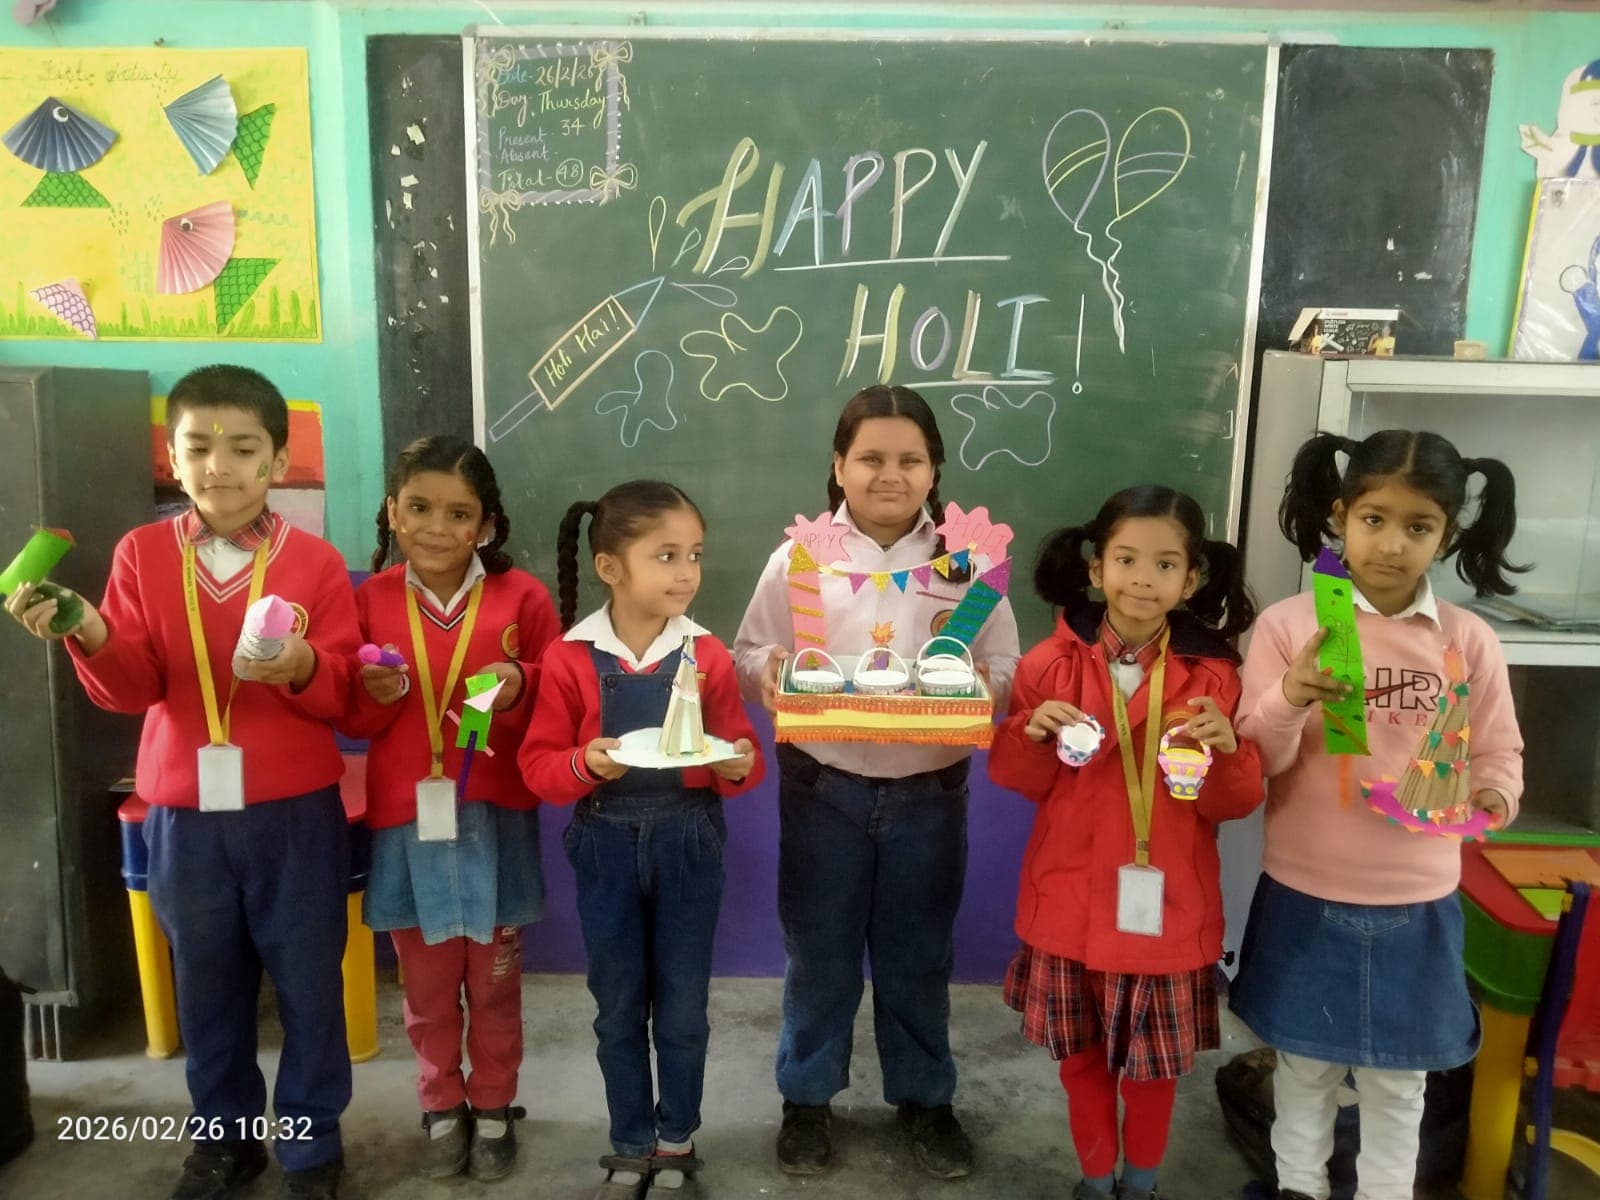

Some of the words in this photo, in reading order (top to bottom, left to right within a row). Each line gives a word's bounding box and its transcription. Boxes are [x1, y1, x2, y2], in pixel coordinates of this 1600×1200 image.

[535, 57, 594, 88] 26/2/26
[538, 88, 606, 129] Thursday
[560, 117, 587, 136] 34
[676, 136, 989, 279] HAPPY
[544, 349, 572, 387] Holi
[574, 303, 621, 354] Hai!
[1364, 667, 1442, 712] IR
